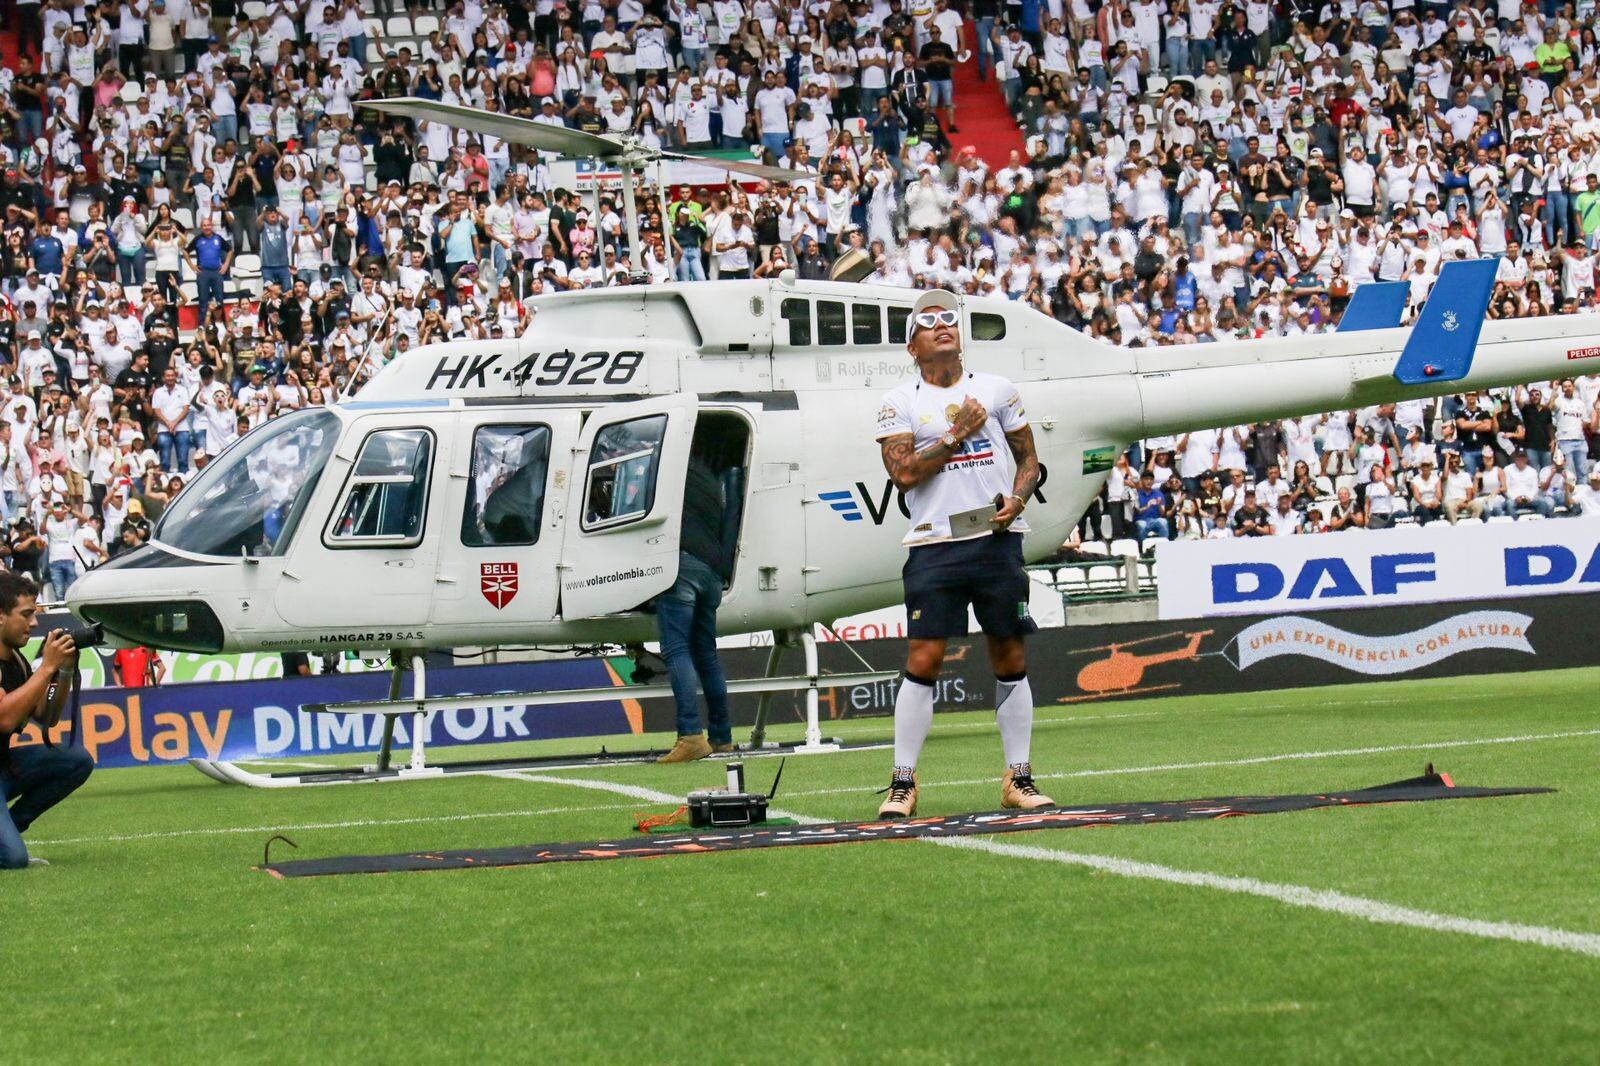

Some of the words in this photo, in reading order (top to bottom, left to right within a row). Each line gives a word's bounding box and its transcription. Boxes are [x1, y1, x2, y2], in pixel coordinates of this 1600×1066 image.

[425, 351, 645, 390] HK-4928
[948, 463, 960, 471] LA
[484, 564, 516, 575] BELL
[565, 565, 664, 590] www.volarcolombia.com
[1211, 552, 1436, 604] DAF
[261, 639, 299, 647] Operado
[320, 633, 374, 643] HANGAR
[377, 632, 393, 641] 29
[396, 631, 425, 640] S.A.S.
[1249, 629, 1286, 651] UNA
[1294, 629, 1408, 662] EXPERIENCIA
[1416, 633, 1449, 655] CON
[1457, 623, 1524, 641] ALTURA
[253, 704, 530, 754] DIMAYOR
